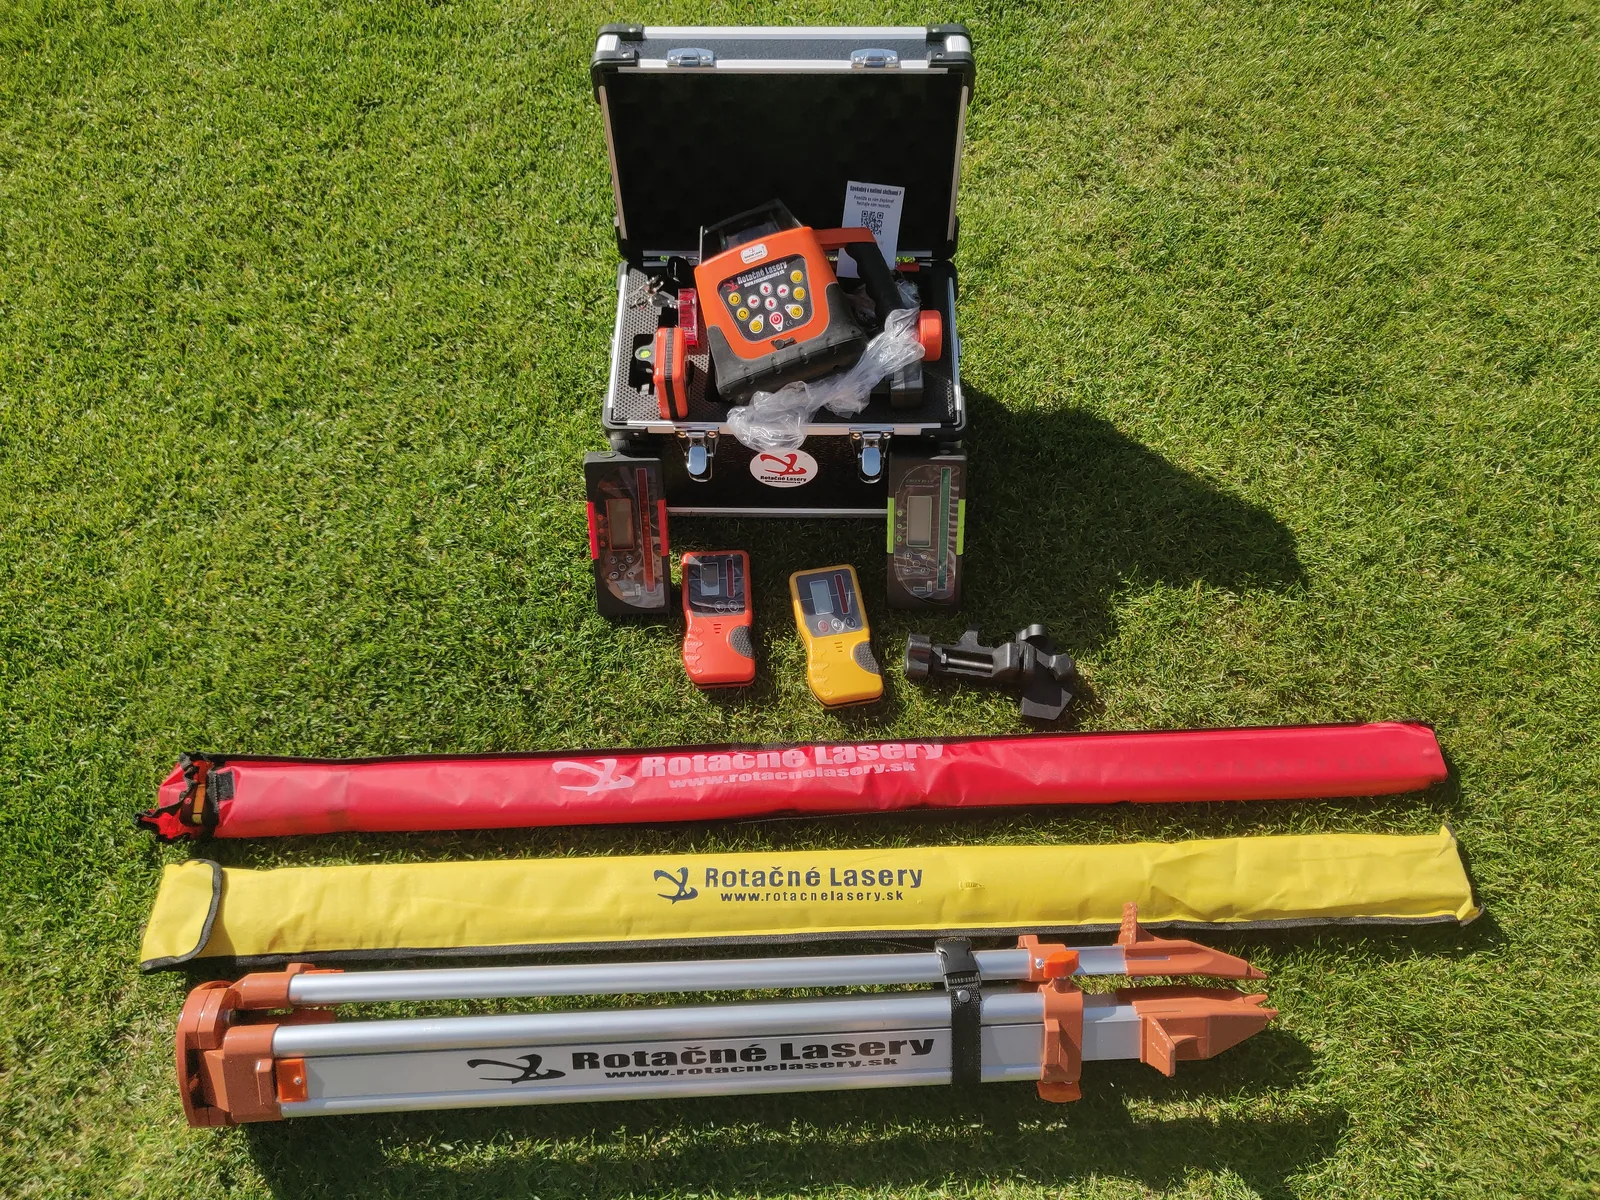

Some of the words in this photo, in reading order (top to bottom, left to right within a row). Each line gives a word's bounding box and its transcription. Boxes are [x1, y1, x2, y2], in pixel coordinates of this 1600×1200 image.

[814, 743, 943, 765] Lasery
[668, 761, 916, 789] www.rotacnelasery.sk
[705, 866, 821, 888] Rotačné
[830, 867, 923, 889] Lasery
[720, 890, 904, 902] www.rotacnelasery.sk
[571, 1043, 767, 1070] Rotačné
[780, 1038, 935, 1061] Lasery
[604, 1057, 898, 1079] www.rotacnelasery.sk
